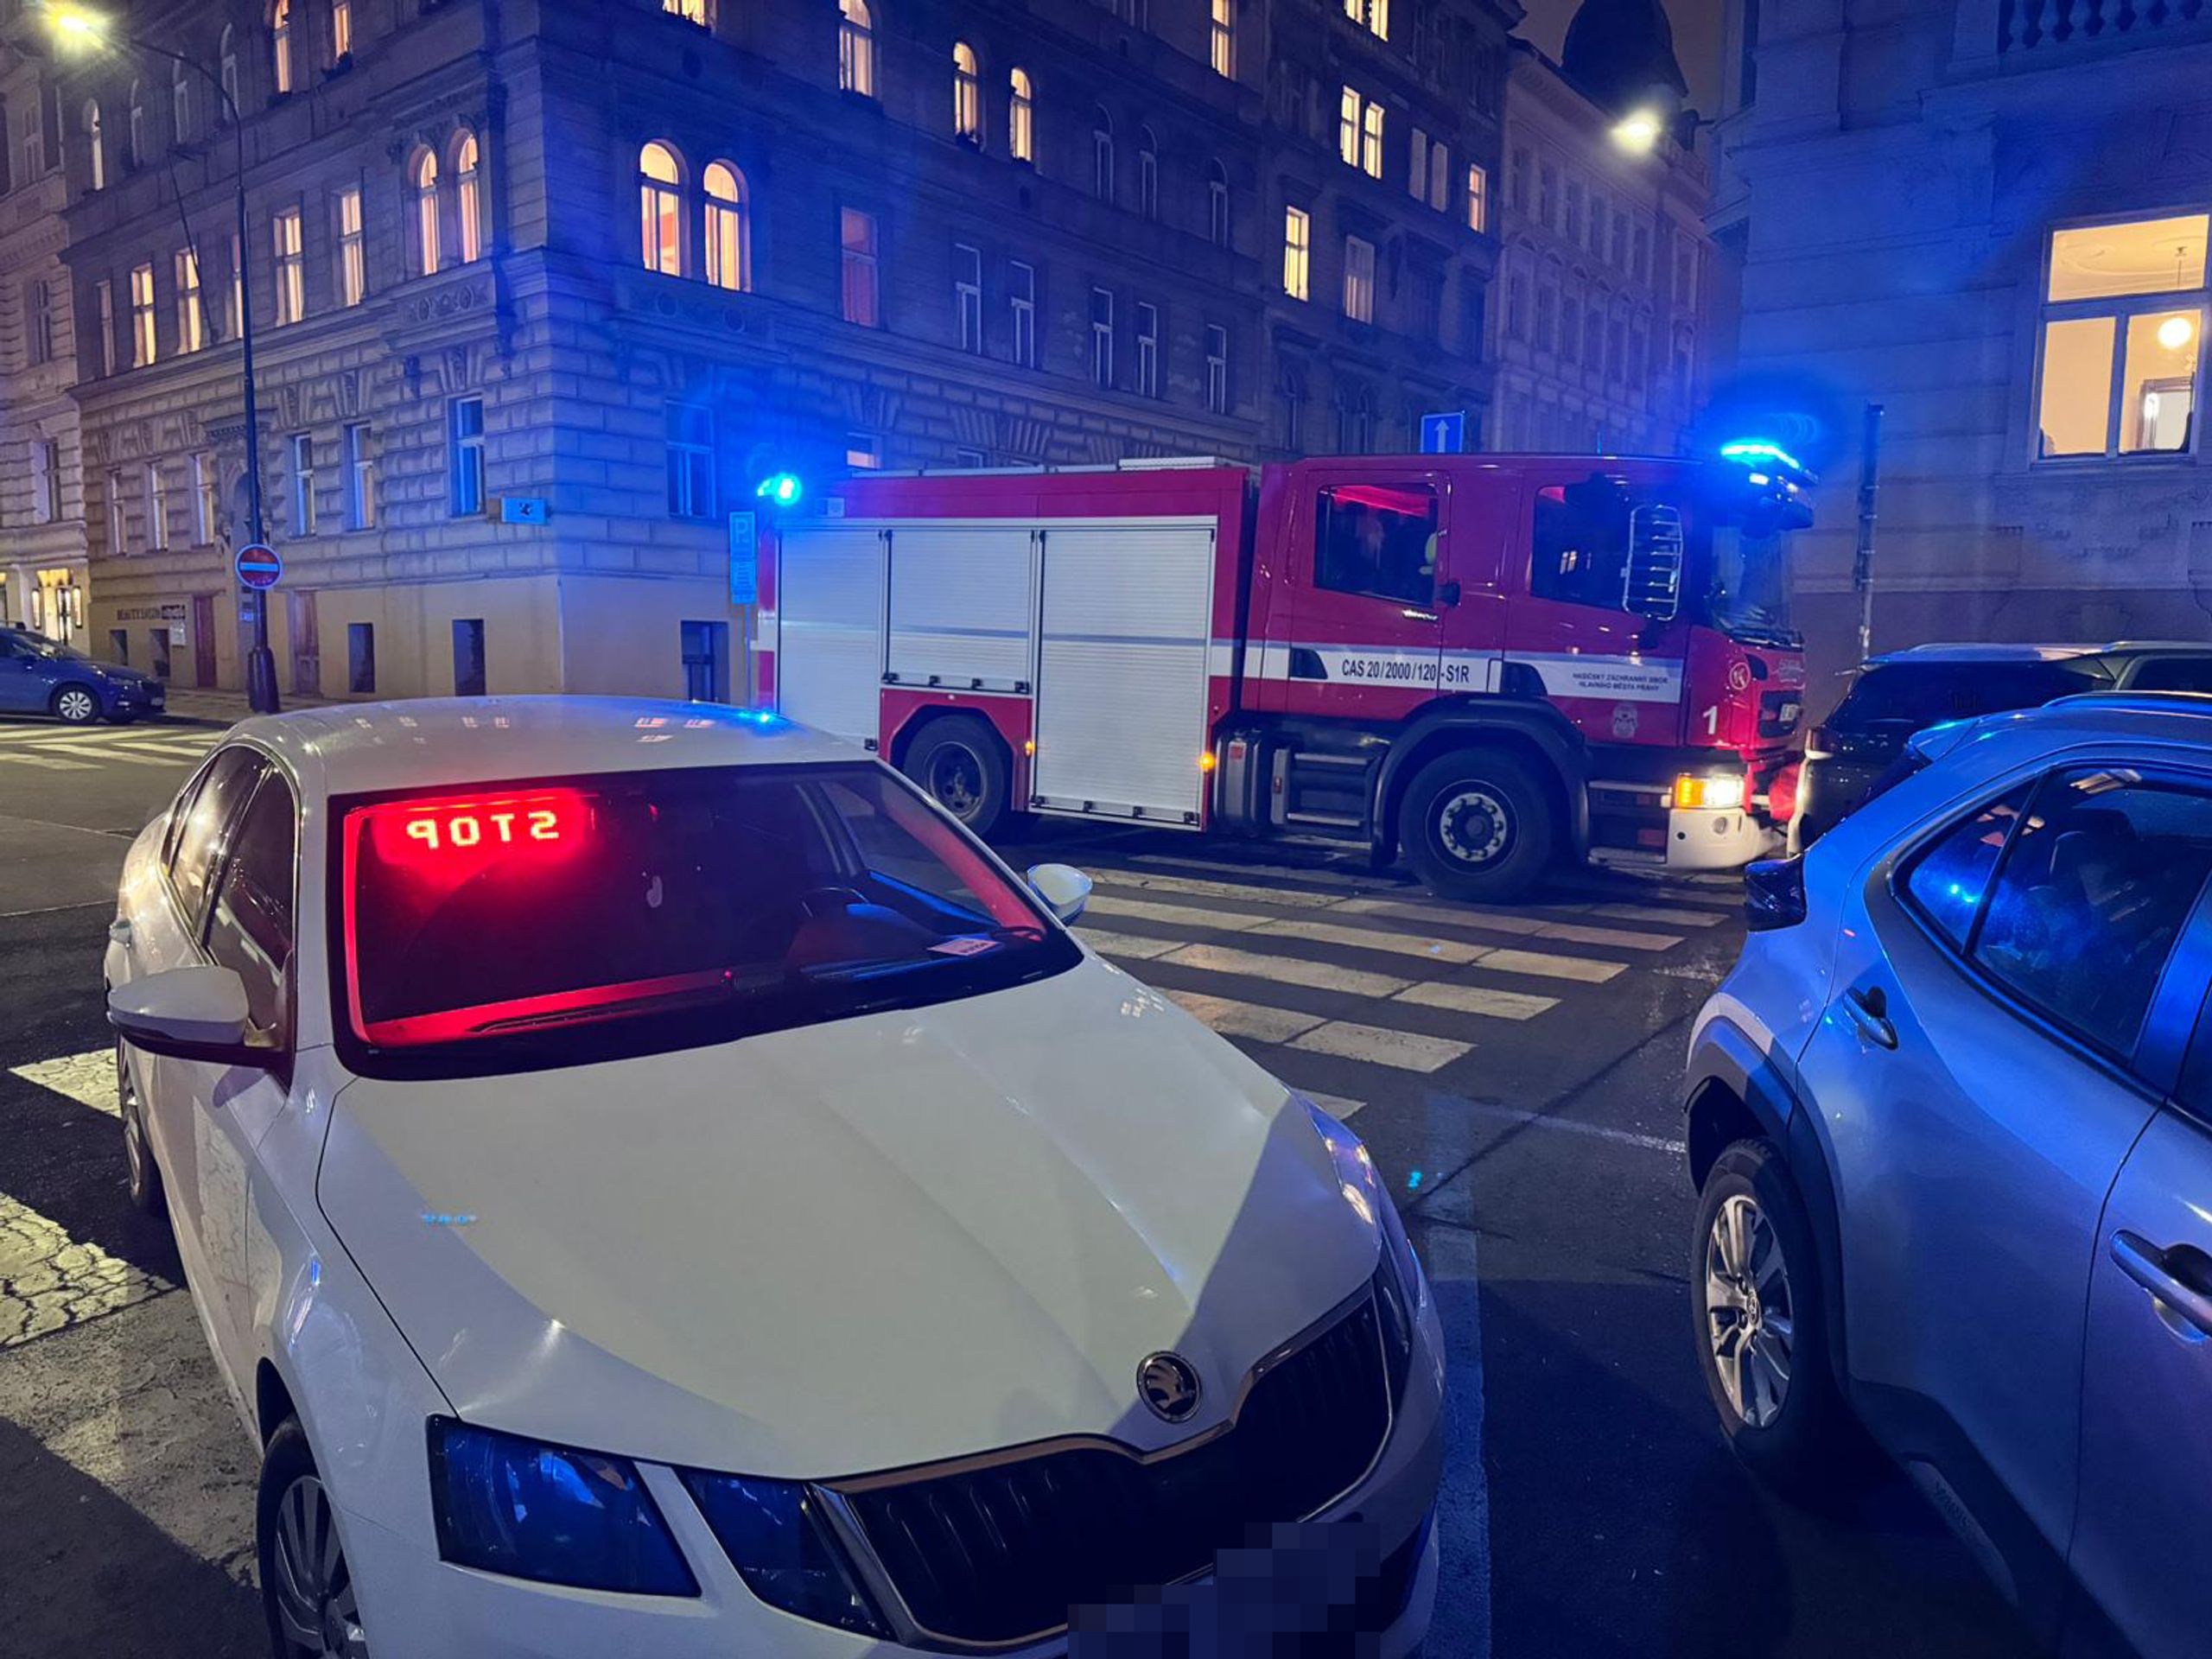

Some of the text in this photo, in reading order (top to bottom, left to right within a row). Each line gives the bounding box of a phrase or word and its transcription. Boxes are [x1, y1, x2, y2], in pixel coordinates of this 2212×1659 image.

[735, 519, 748, 543] P
[1342, 659, 1364, 677] CAS
[1703, 705, 1718, 735] 1
